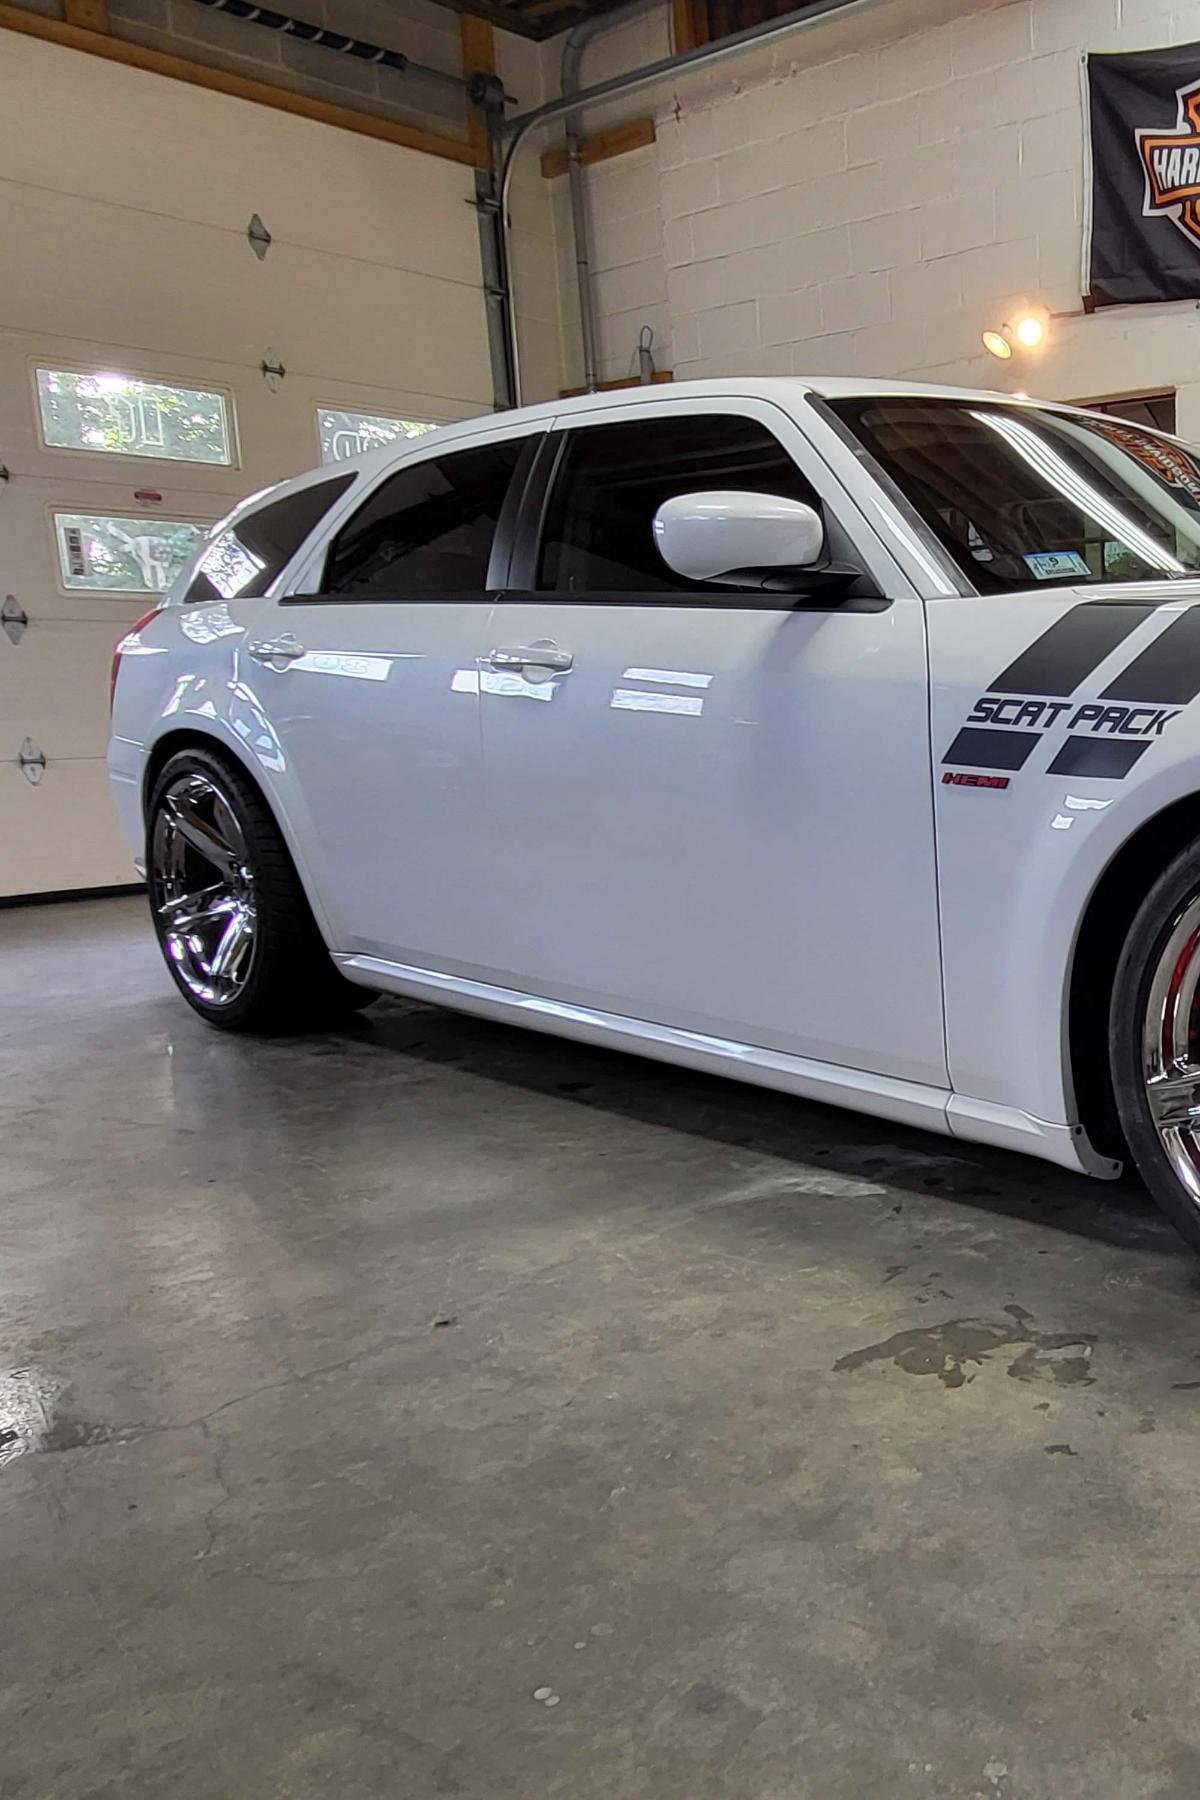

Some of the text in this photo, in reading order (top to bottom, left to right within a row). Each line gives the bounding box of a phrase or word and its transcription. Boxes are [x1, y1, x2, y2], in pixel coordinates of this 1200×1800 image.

[966, 697, 1183, 736] SCAT PACK
[941, 772, 1010, 789] HEMI
